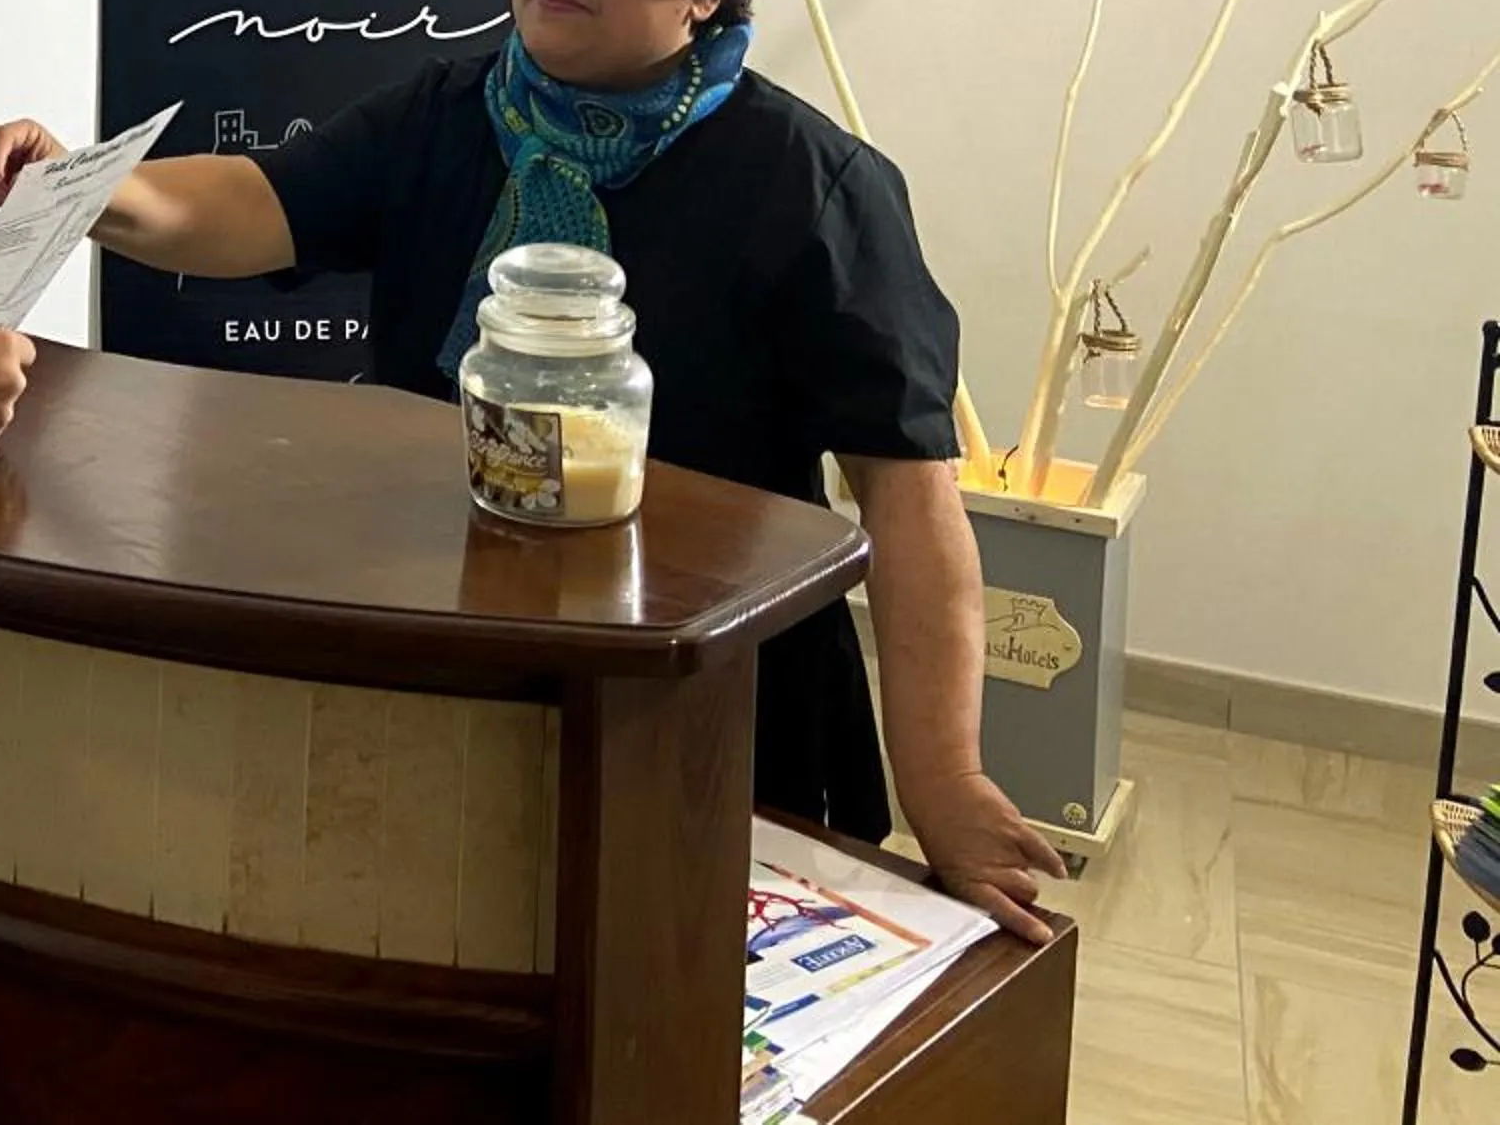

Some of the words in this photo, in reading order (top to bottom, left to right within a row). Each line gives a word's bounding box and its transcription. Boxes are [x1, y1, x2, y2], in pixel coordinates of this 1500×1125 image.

[169, 5, 512, 44] noir
[225, 320, 280, 342] EAU
[295, 320, 331, 340] DE
